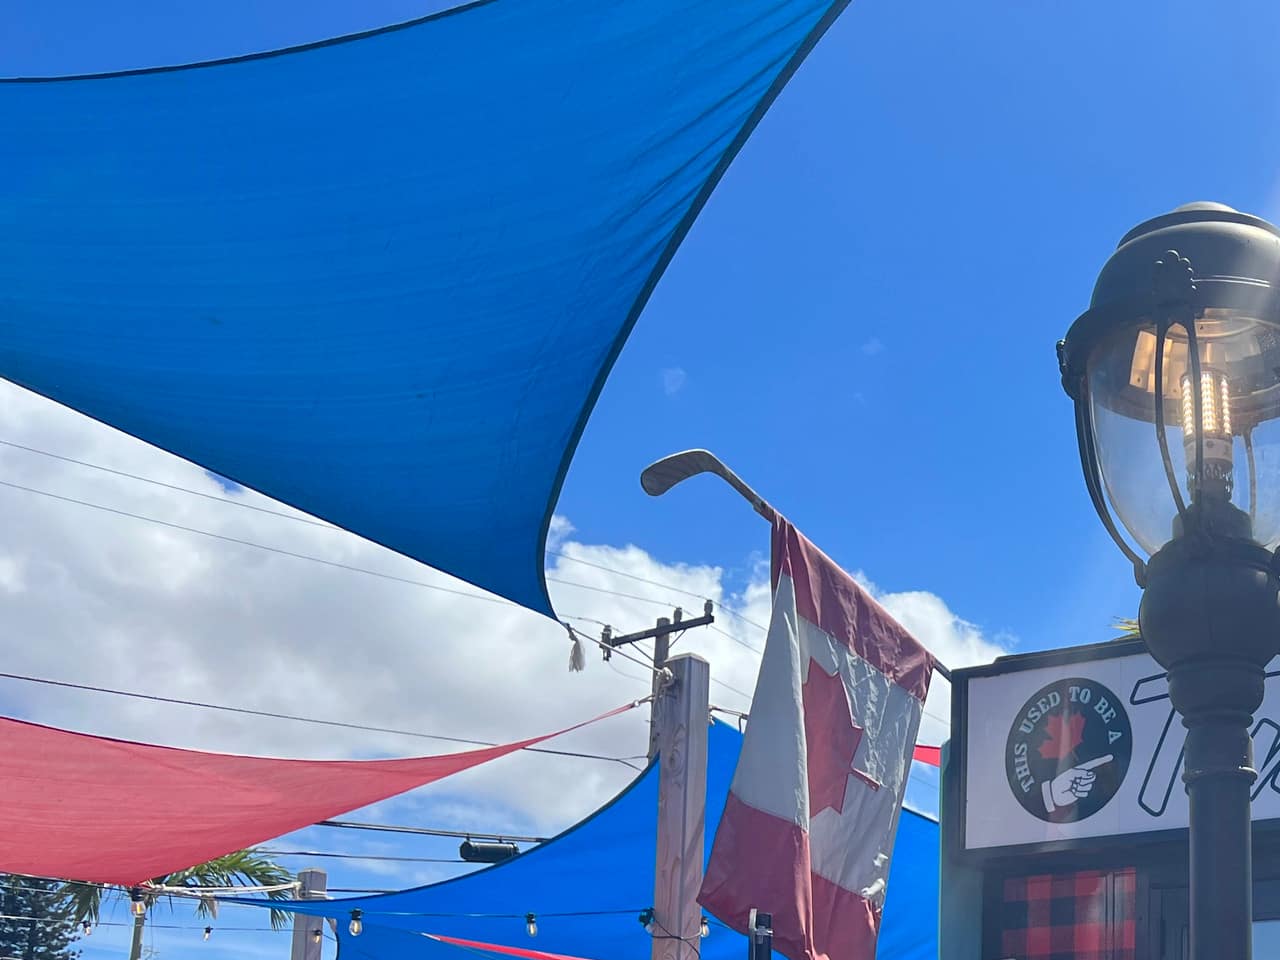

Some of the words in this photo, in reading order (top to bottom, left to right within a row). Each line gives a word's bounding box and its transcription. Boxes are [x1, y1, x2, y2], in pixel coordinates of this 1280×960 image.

[1068, 686, 1092, 703] TO
[1018, 691, 1061, 735] USED
[1093, 696, 1118, 725] BE
[1108, 729, 1123, 745] A
[1014, 743, 1036, 793] THIS
